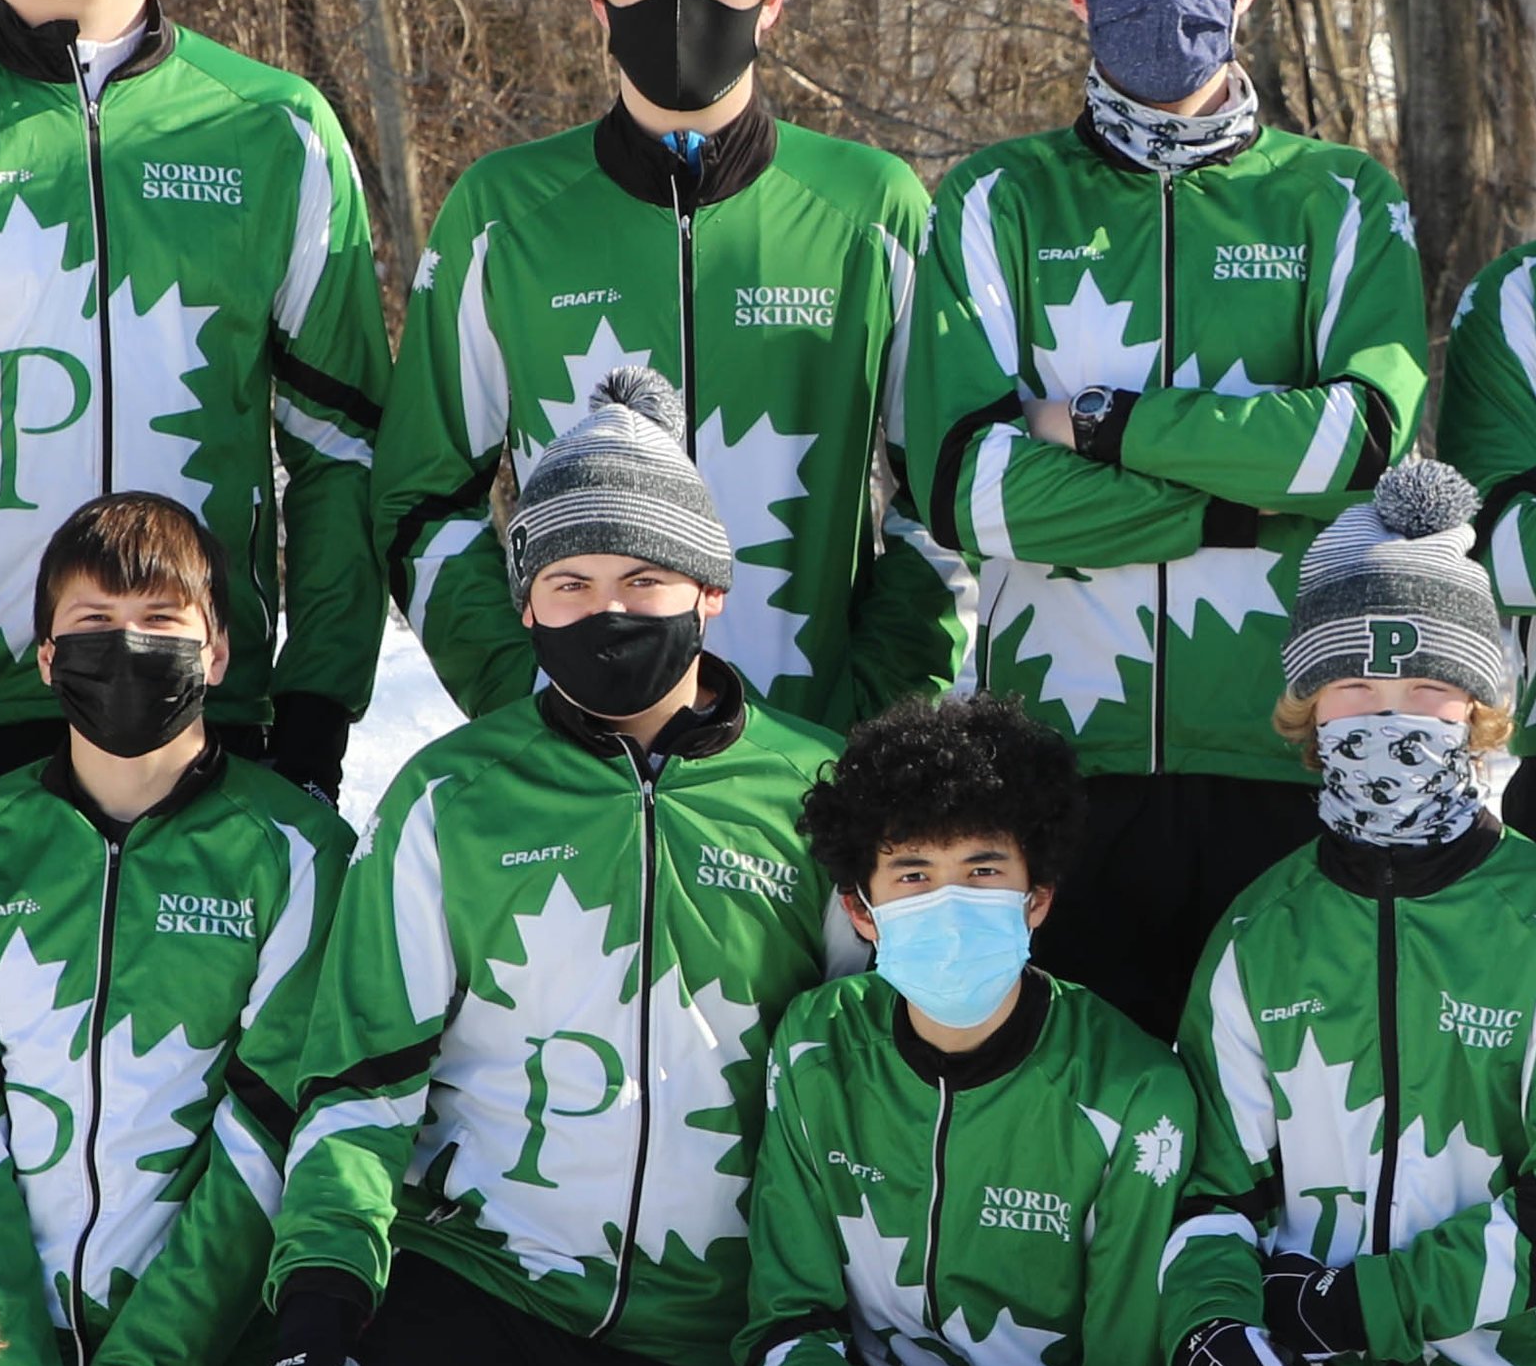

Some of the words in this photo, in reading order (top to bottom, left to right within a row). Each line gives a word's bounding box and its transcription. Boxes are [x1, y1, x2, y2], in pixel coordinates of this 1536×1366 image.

[142, 162, 242, 186] NORDIC
[142, 180, 242, 206] SKIING
[551, 290, 606, 309] CRAFT
[735, 287, 835, 307] NORDIC
[735, 304, 834, 327] SKIING
[1366, 618, 1419, 676] P
[502, 846, 562, 867] CRAFT
[701, 844, 799, 885] NORDIC
[502, 1030, 626, 1189] P
[1157, 1138, 1173, 1165] P
